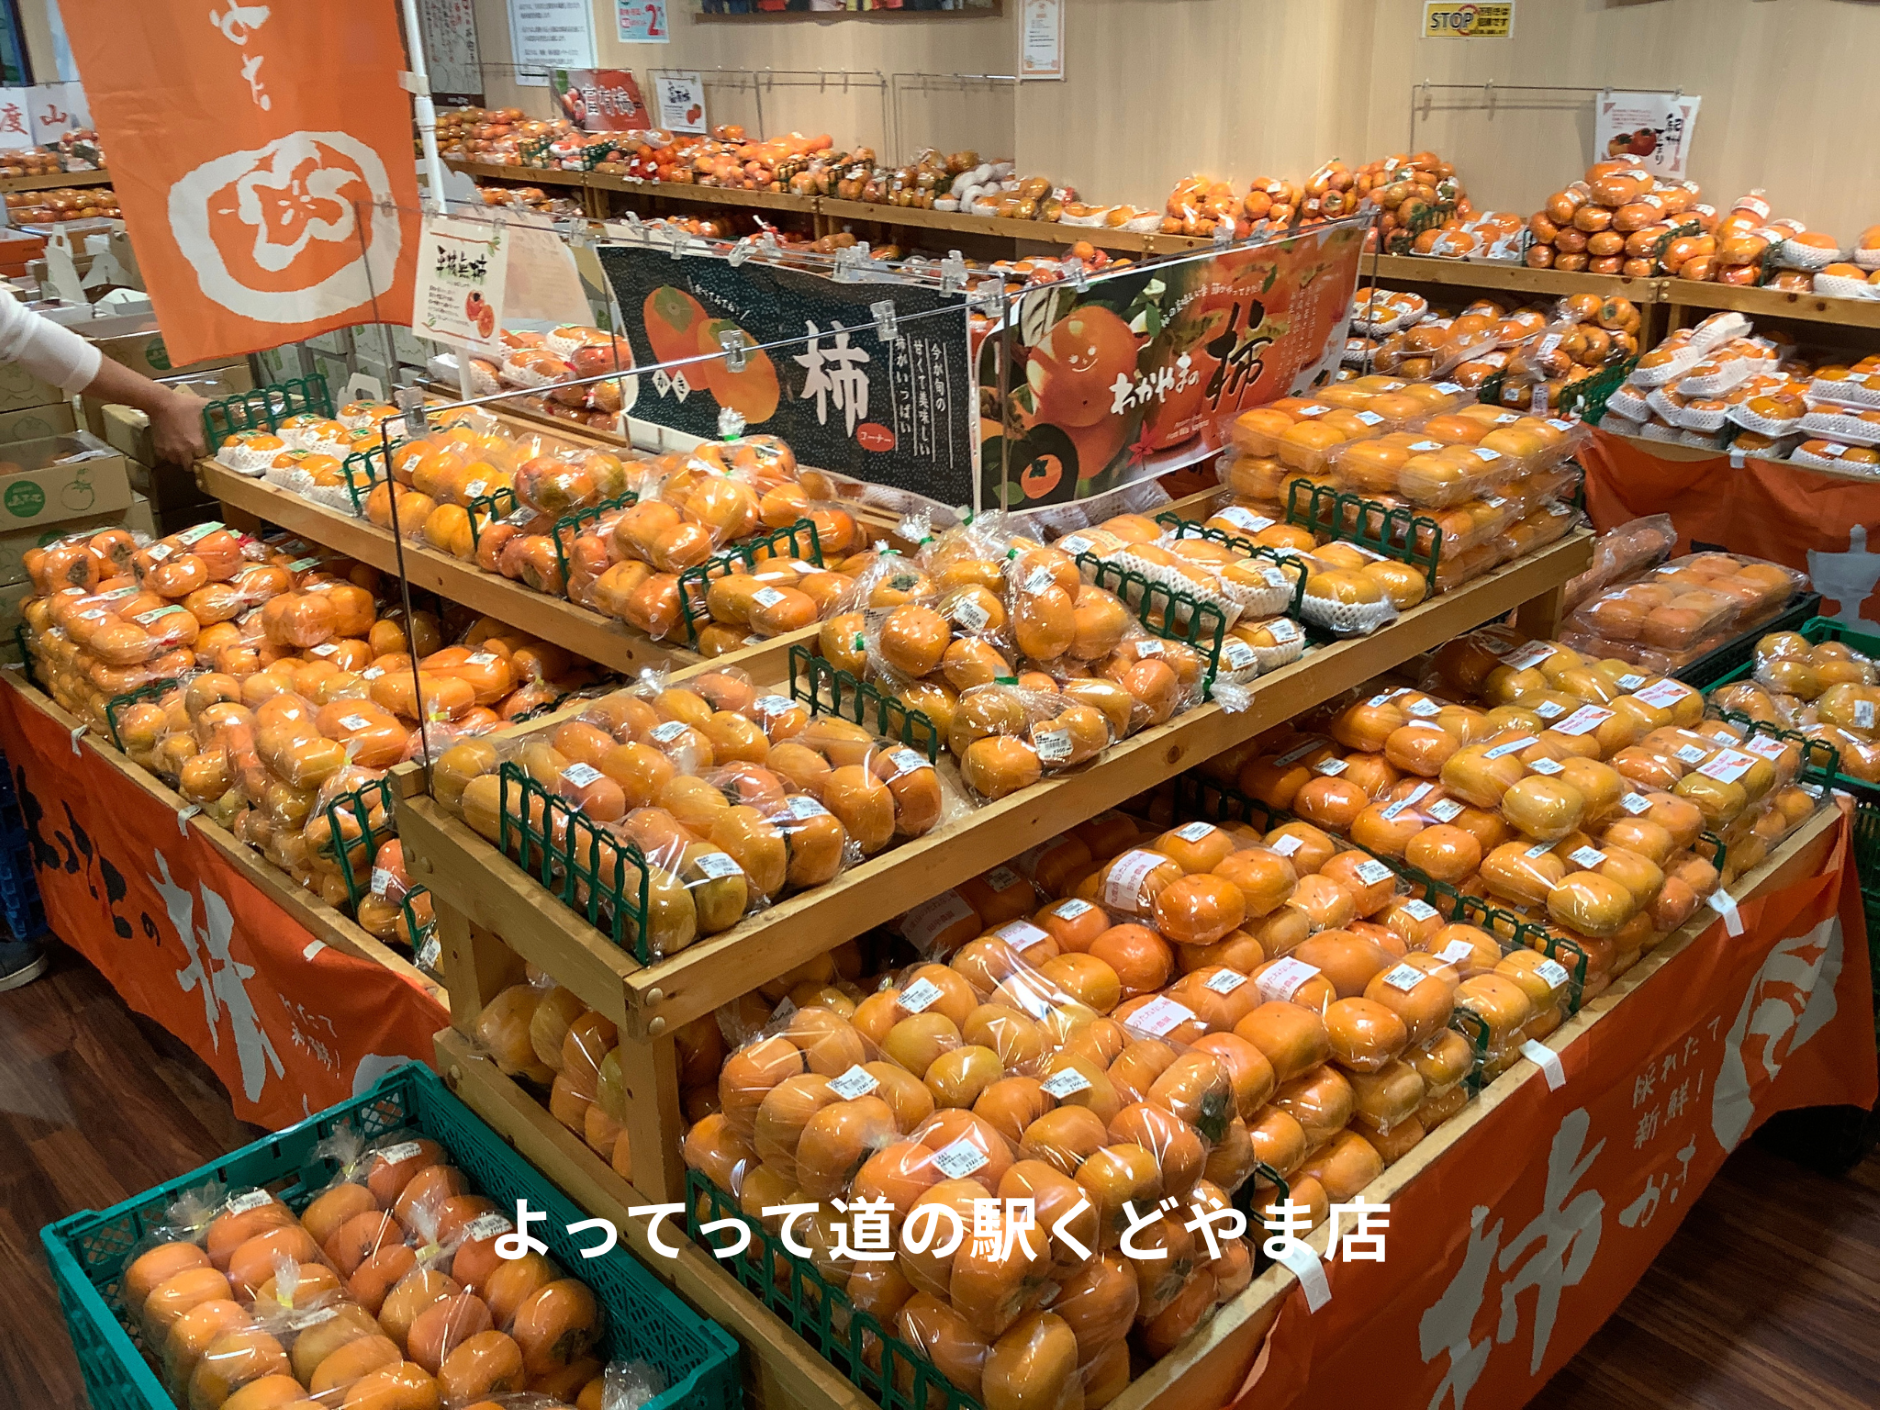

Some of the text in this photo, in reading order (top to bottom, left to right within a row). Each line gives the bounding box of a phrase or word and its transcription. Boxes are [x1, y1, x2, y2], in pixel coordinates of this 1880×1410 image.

[1430, 12, 1474, 30] STOP
[793, 319, 872, 438] 柿
[913, 338, 931, 456] 甘くて美味しい
[930, 343, 947, 413] 今が旬の
[1109, 352, 1200, 416] わかやまの
[1204, 299, 1273, 413] 柿
[860, 431, 892, 444] コーナー
[1418, 1106, 1608, 1410] 柿
